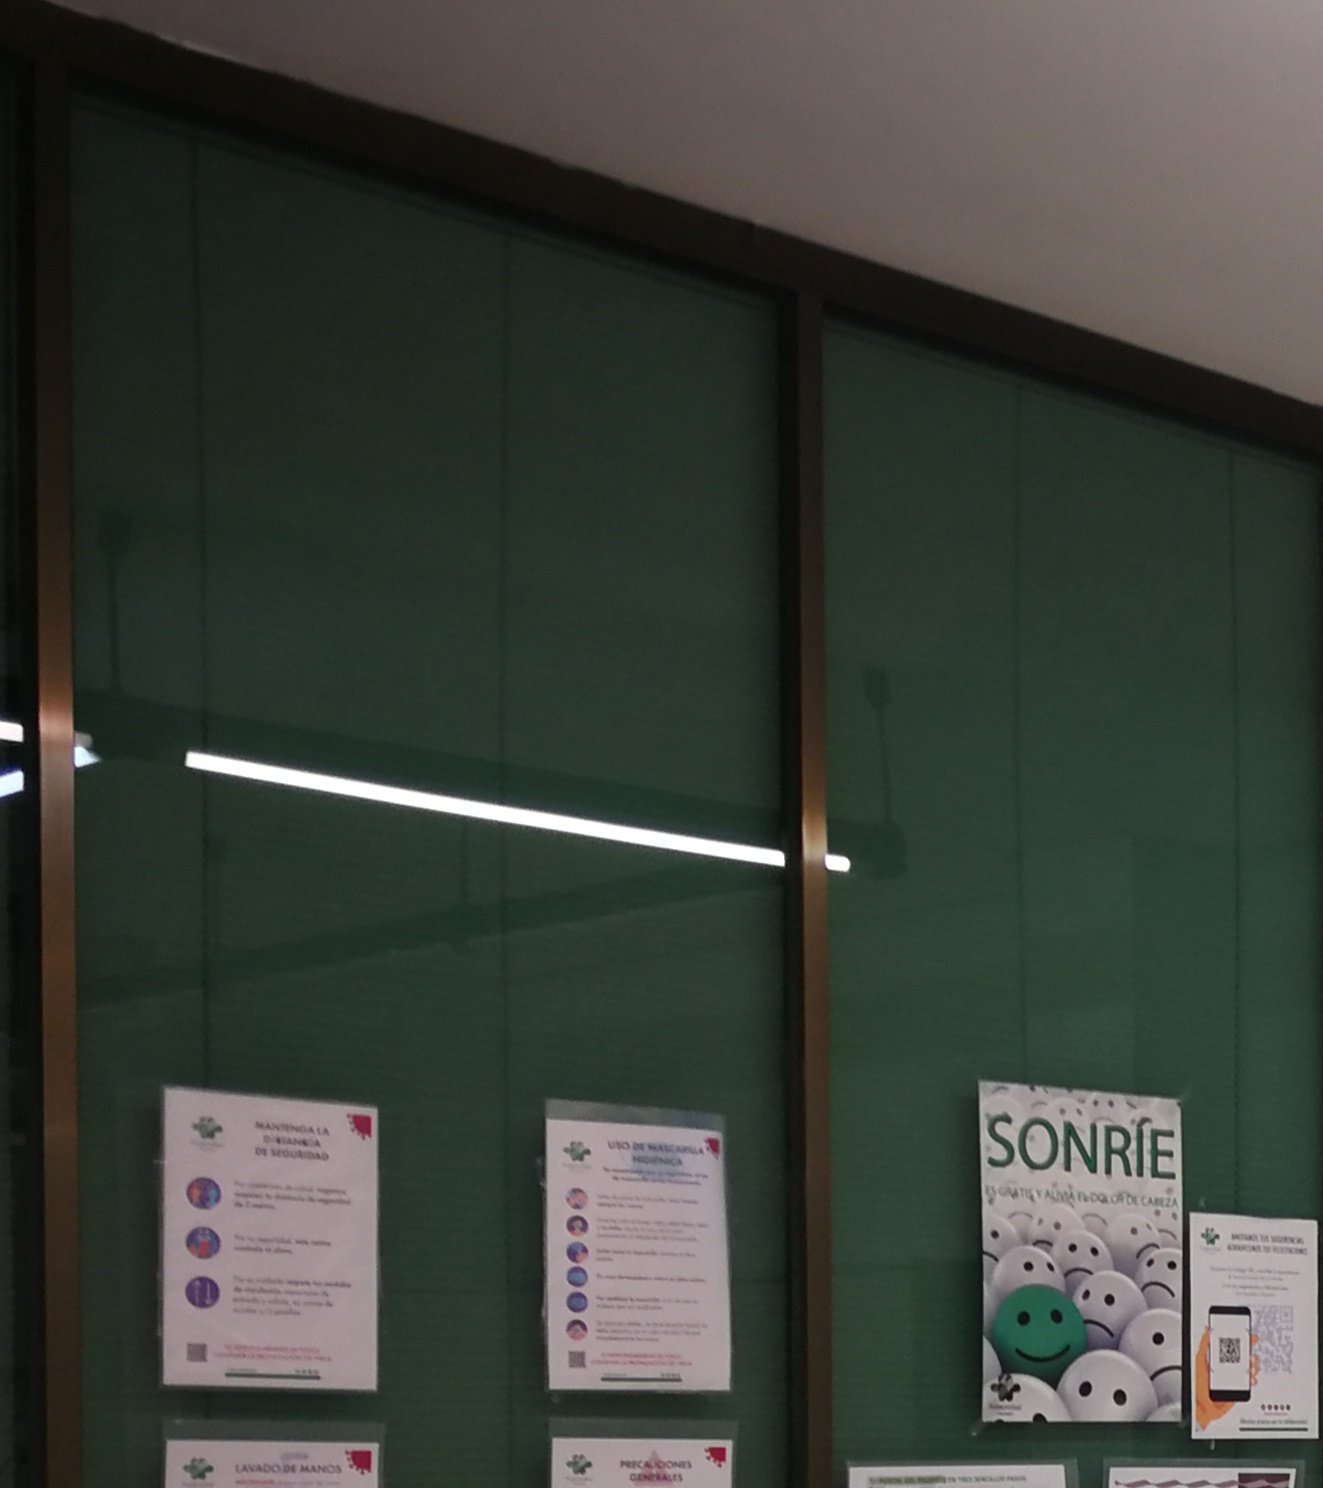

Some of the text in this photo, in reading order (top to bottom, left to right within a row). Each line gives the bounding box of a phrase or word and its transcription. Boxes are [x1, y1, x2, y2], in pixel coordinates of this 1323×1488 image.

[255, 1120, 331, 1136] MANTENGA LA
[607, 1140, 630, 1151] USO
[987, 1111, 1176, 1181] SONRÍE
[254, 1145, 329, 1161] DE SEGURIDAD
[235, 1463, 342, 1475] LAVADO DE MANOS
[619, 1459, 693, 1470] PRECAUCIONES
[629, 1473, 684, 1483] GENERALES
